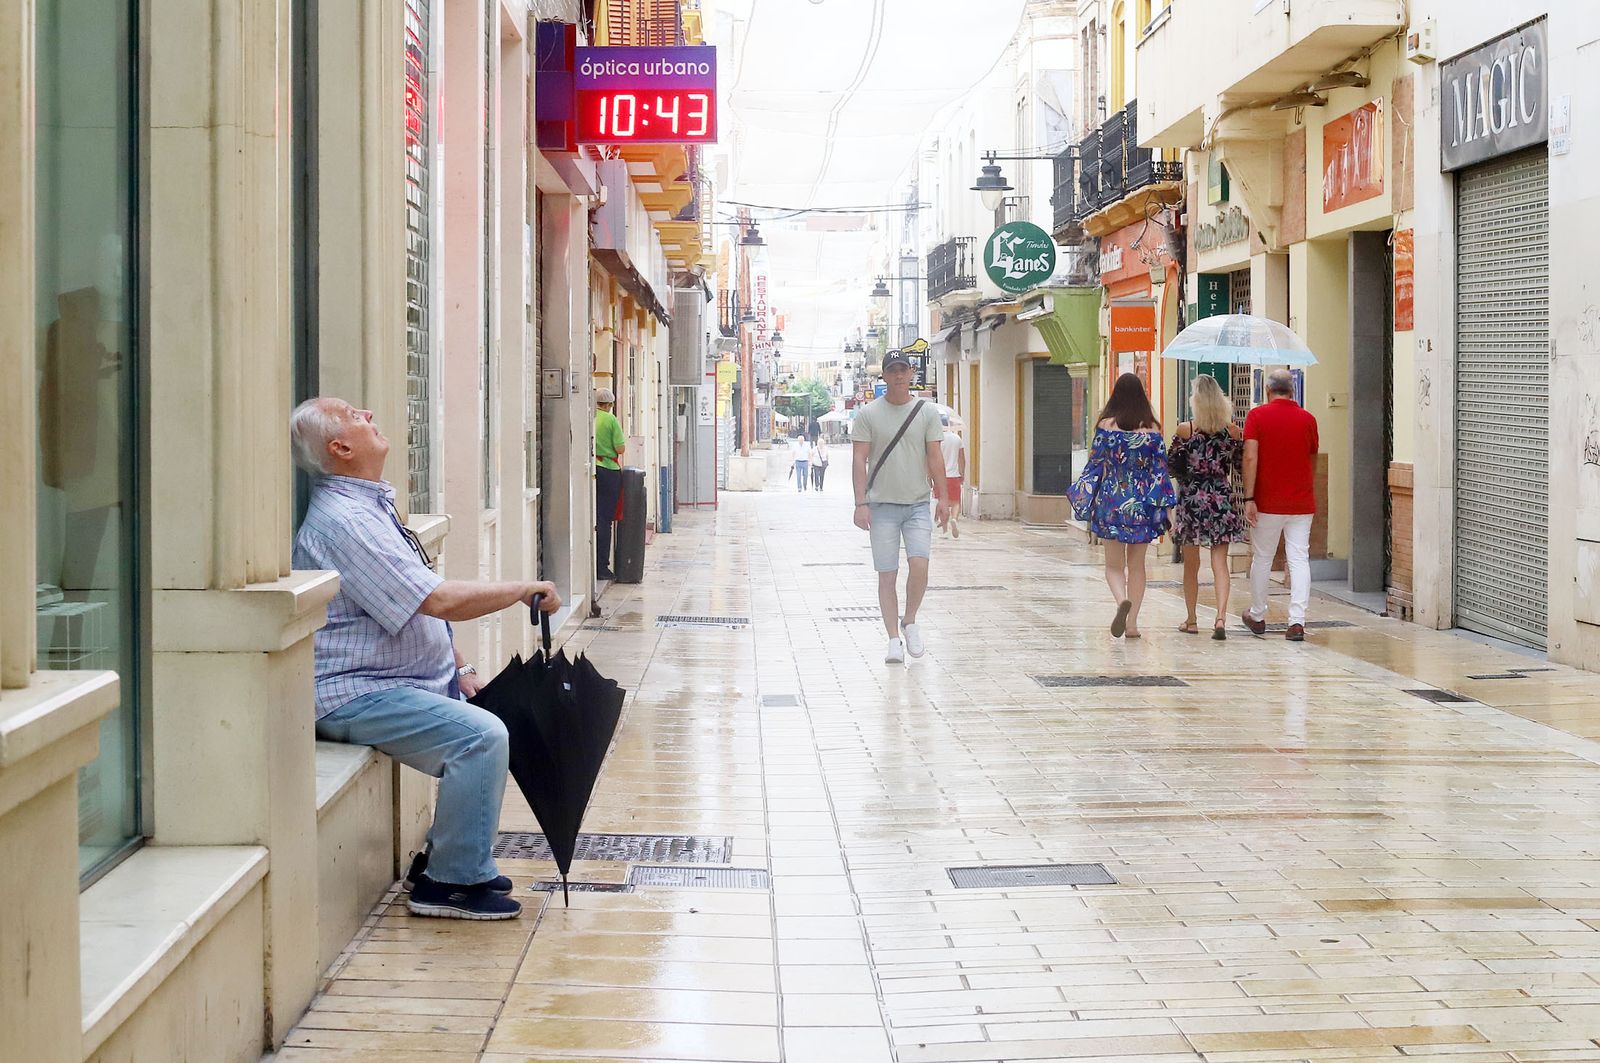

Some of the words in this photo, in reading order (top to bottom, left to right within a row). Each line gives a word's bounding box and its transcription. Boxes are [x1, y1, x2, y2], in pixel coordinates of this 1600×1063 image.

[580, 57, 640, 79] óptica
[644, 58, 710, 75] urbano
[599, 94, 709, 136] 10:43
[1451, 45, 1537, 147] MAGIC
[757, 275, 767, 341] RESTAURANTE
